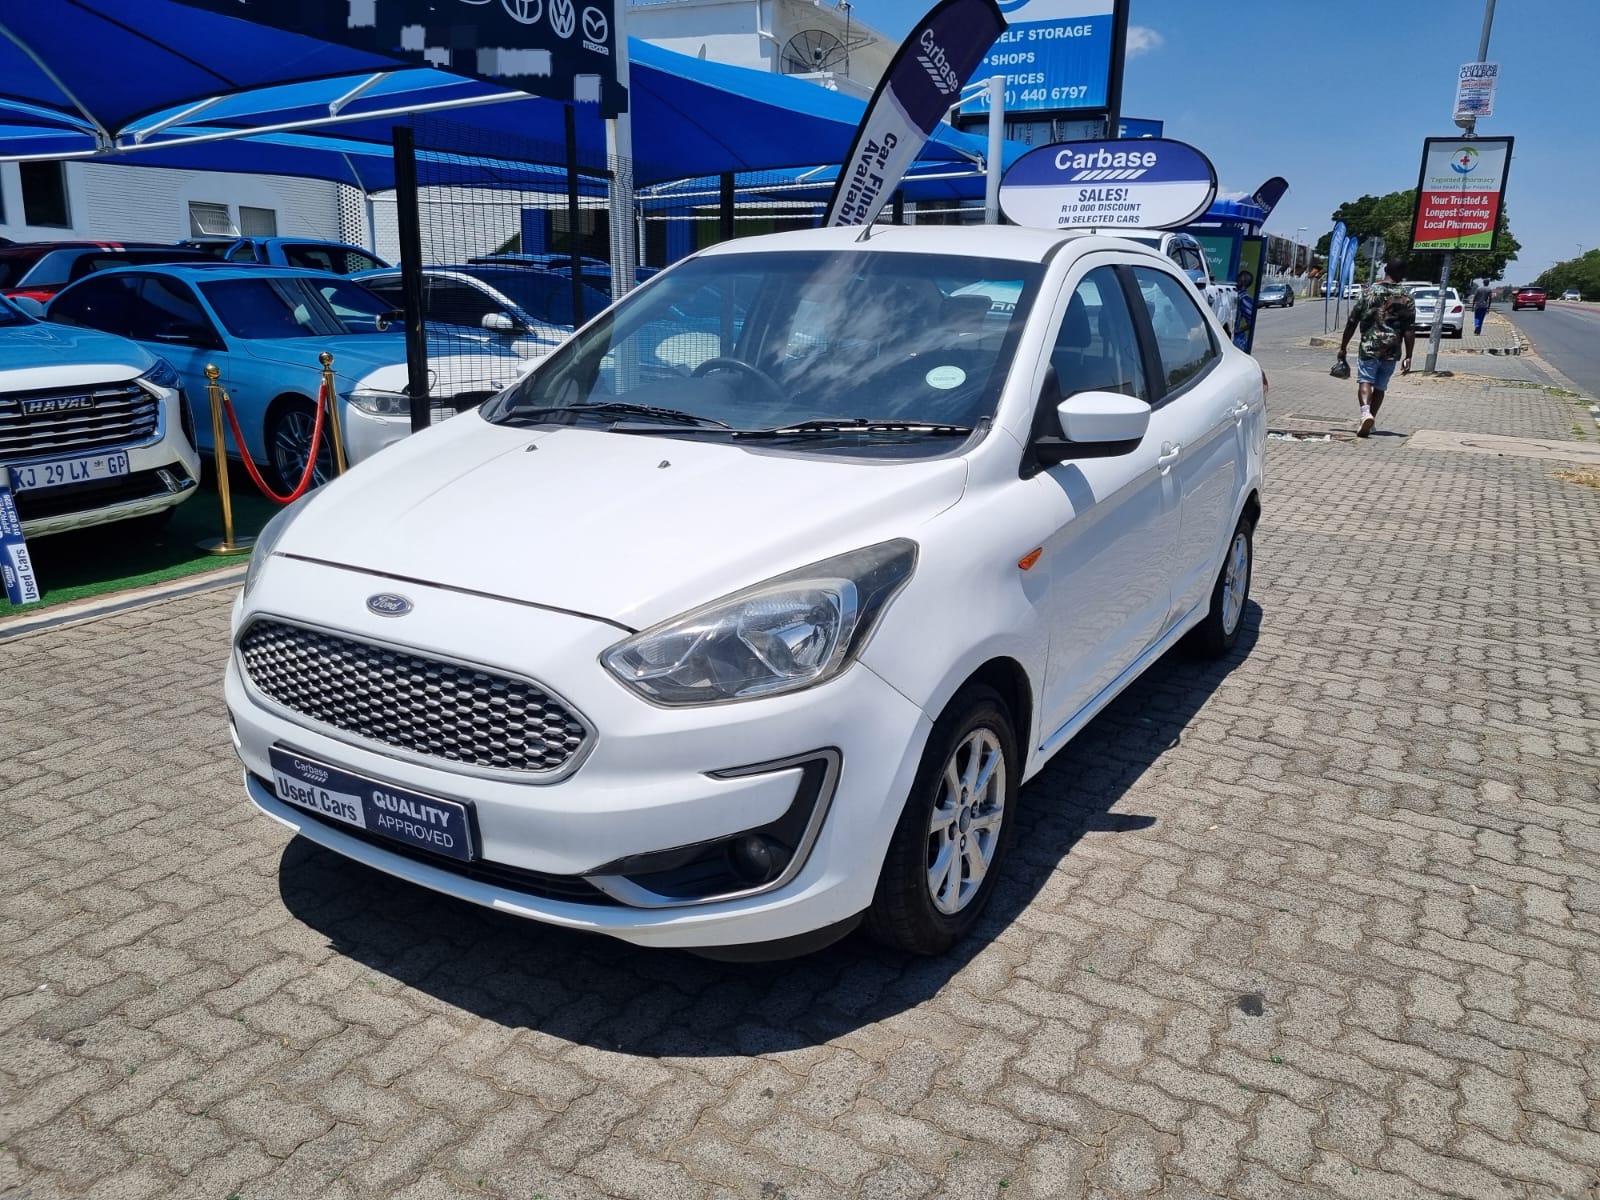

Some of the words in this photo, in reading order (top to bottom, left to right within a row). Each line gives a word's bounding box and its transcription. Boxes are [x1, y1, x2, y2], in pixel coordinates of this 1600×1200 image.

[1028, 25, 1092, 40] STORAGE
[583, 40, 609, 55] mazda
[920, 28, 959, 92] Carbase
[991, 52, 1035, 65] SHOPS
[1006, 73, 1045, 85] FICES
[1460, 70, 1497, 78] COLLEGE
[1020, 88, 1046, 101] 440
[1051, 86, 1087, 100] 6797
[876, 132, 898, 170] Car
[1055, 149, 1157, 170] Carbase
[835, 139, 880, 225] Availabl
[1078, 188, 1128, 202] SALES!
[1431, 195, 1448, 205] Your
[1450, 195, 1480, 205] Trusted
[1481, 196, 1488, 205] &
[1061, 205, 1077, 213] R10
[1080, 204, 1095, 212] 000
[1098, 203, 1141, 212] DISCOUNT
[1425, 208, 1457, 218] Longest
[1459, 208, 1490, 218] Serving
[1058, 216, 1069, 224] ON
[1072, 215, 1114, 224] SELECTED
[1117, 215, 1140, 223] CARS
[1424, 220, 1445, 229] Local
[1446, 220, 1487, 231] Pharmacy
[29, 397, 91, 413] HAVAL
[17, 468, 36, 488] KJ
[45, 464, 64, 484] 29
[69, 460, 90, 480] LX
[108, 455, 125, 474] GP
[16, 549, 30, 572] Cars
[22, 575, 38, 600] Used
[373, 596, 402, 610] Ford
[294, 759, 329, 778] Carbase
[278, 776, 315, 807] Used
[320, 791, 357, 822] Cars
[372, 790, 450, 828] QUALITY
[378, 813, 454, 849] APPROVED
